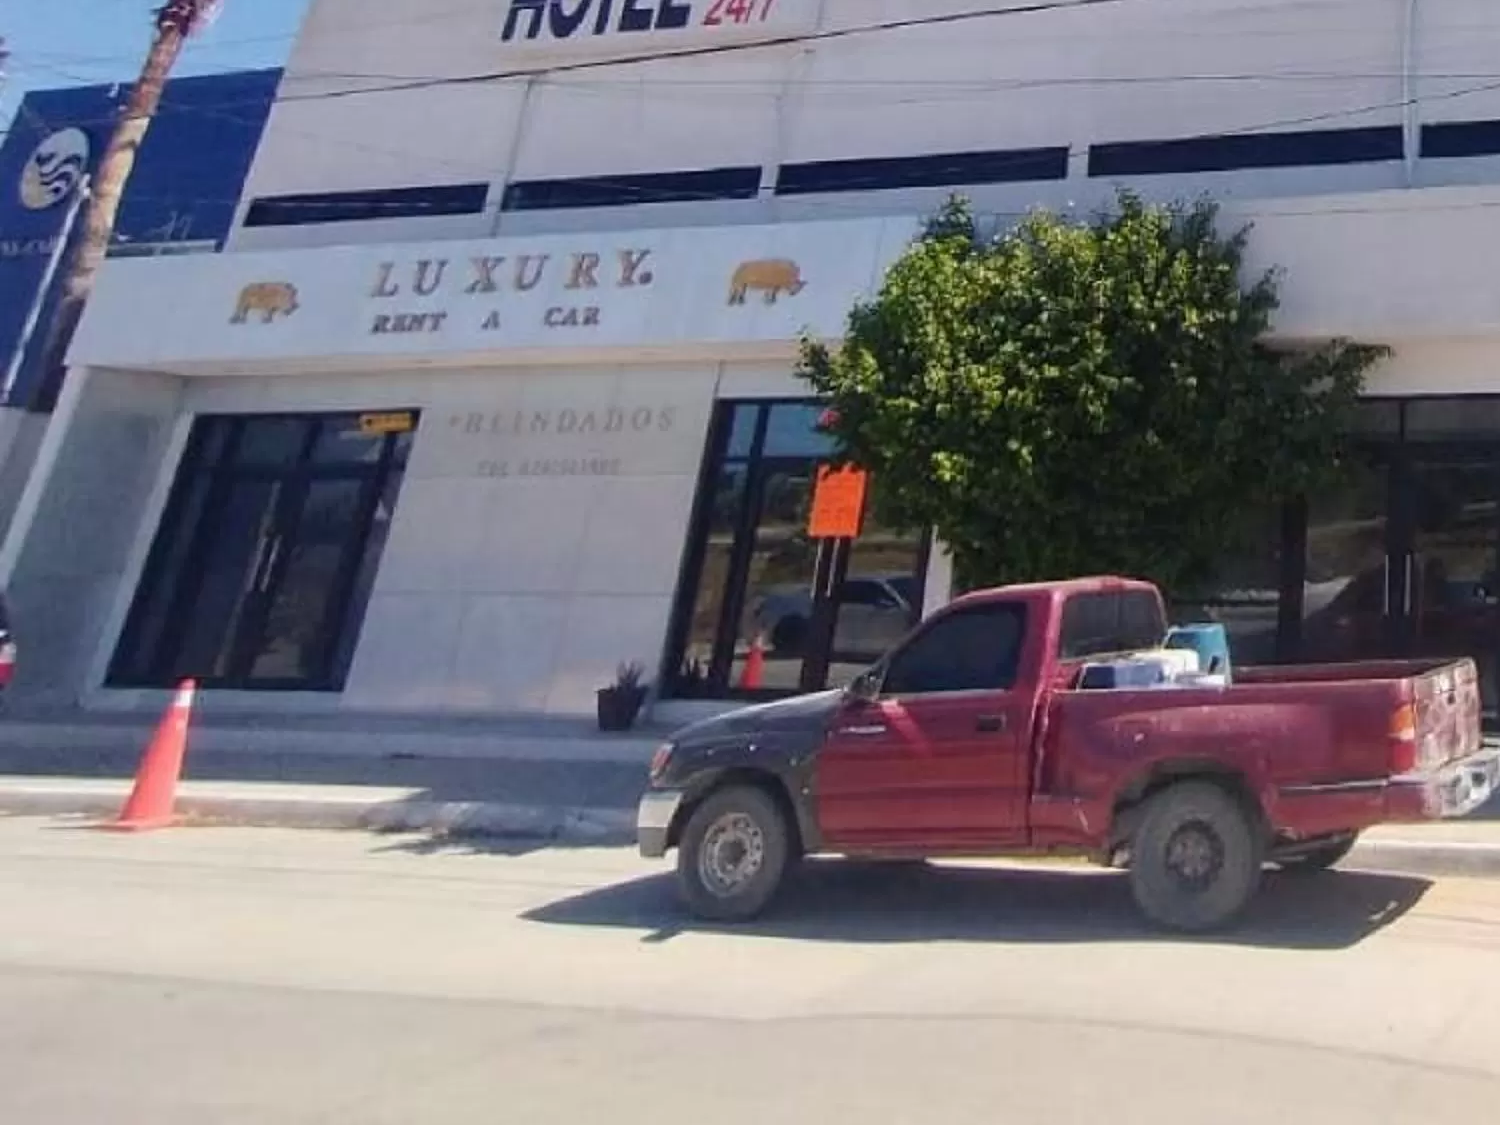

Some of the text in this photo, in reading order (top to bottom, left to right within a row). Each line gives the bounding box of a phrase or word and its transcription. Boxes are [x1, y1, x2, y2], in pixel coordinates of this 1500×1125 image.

[371, 306, 600, 334] RENT A CAR
